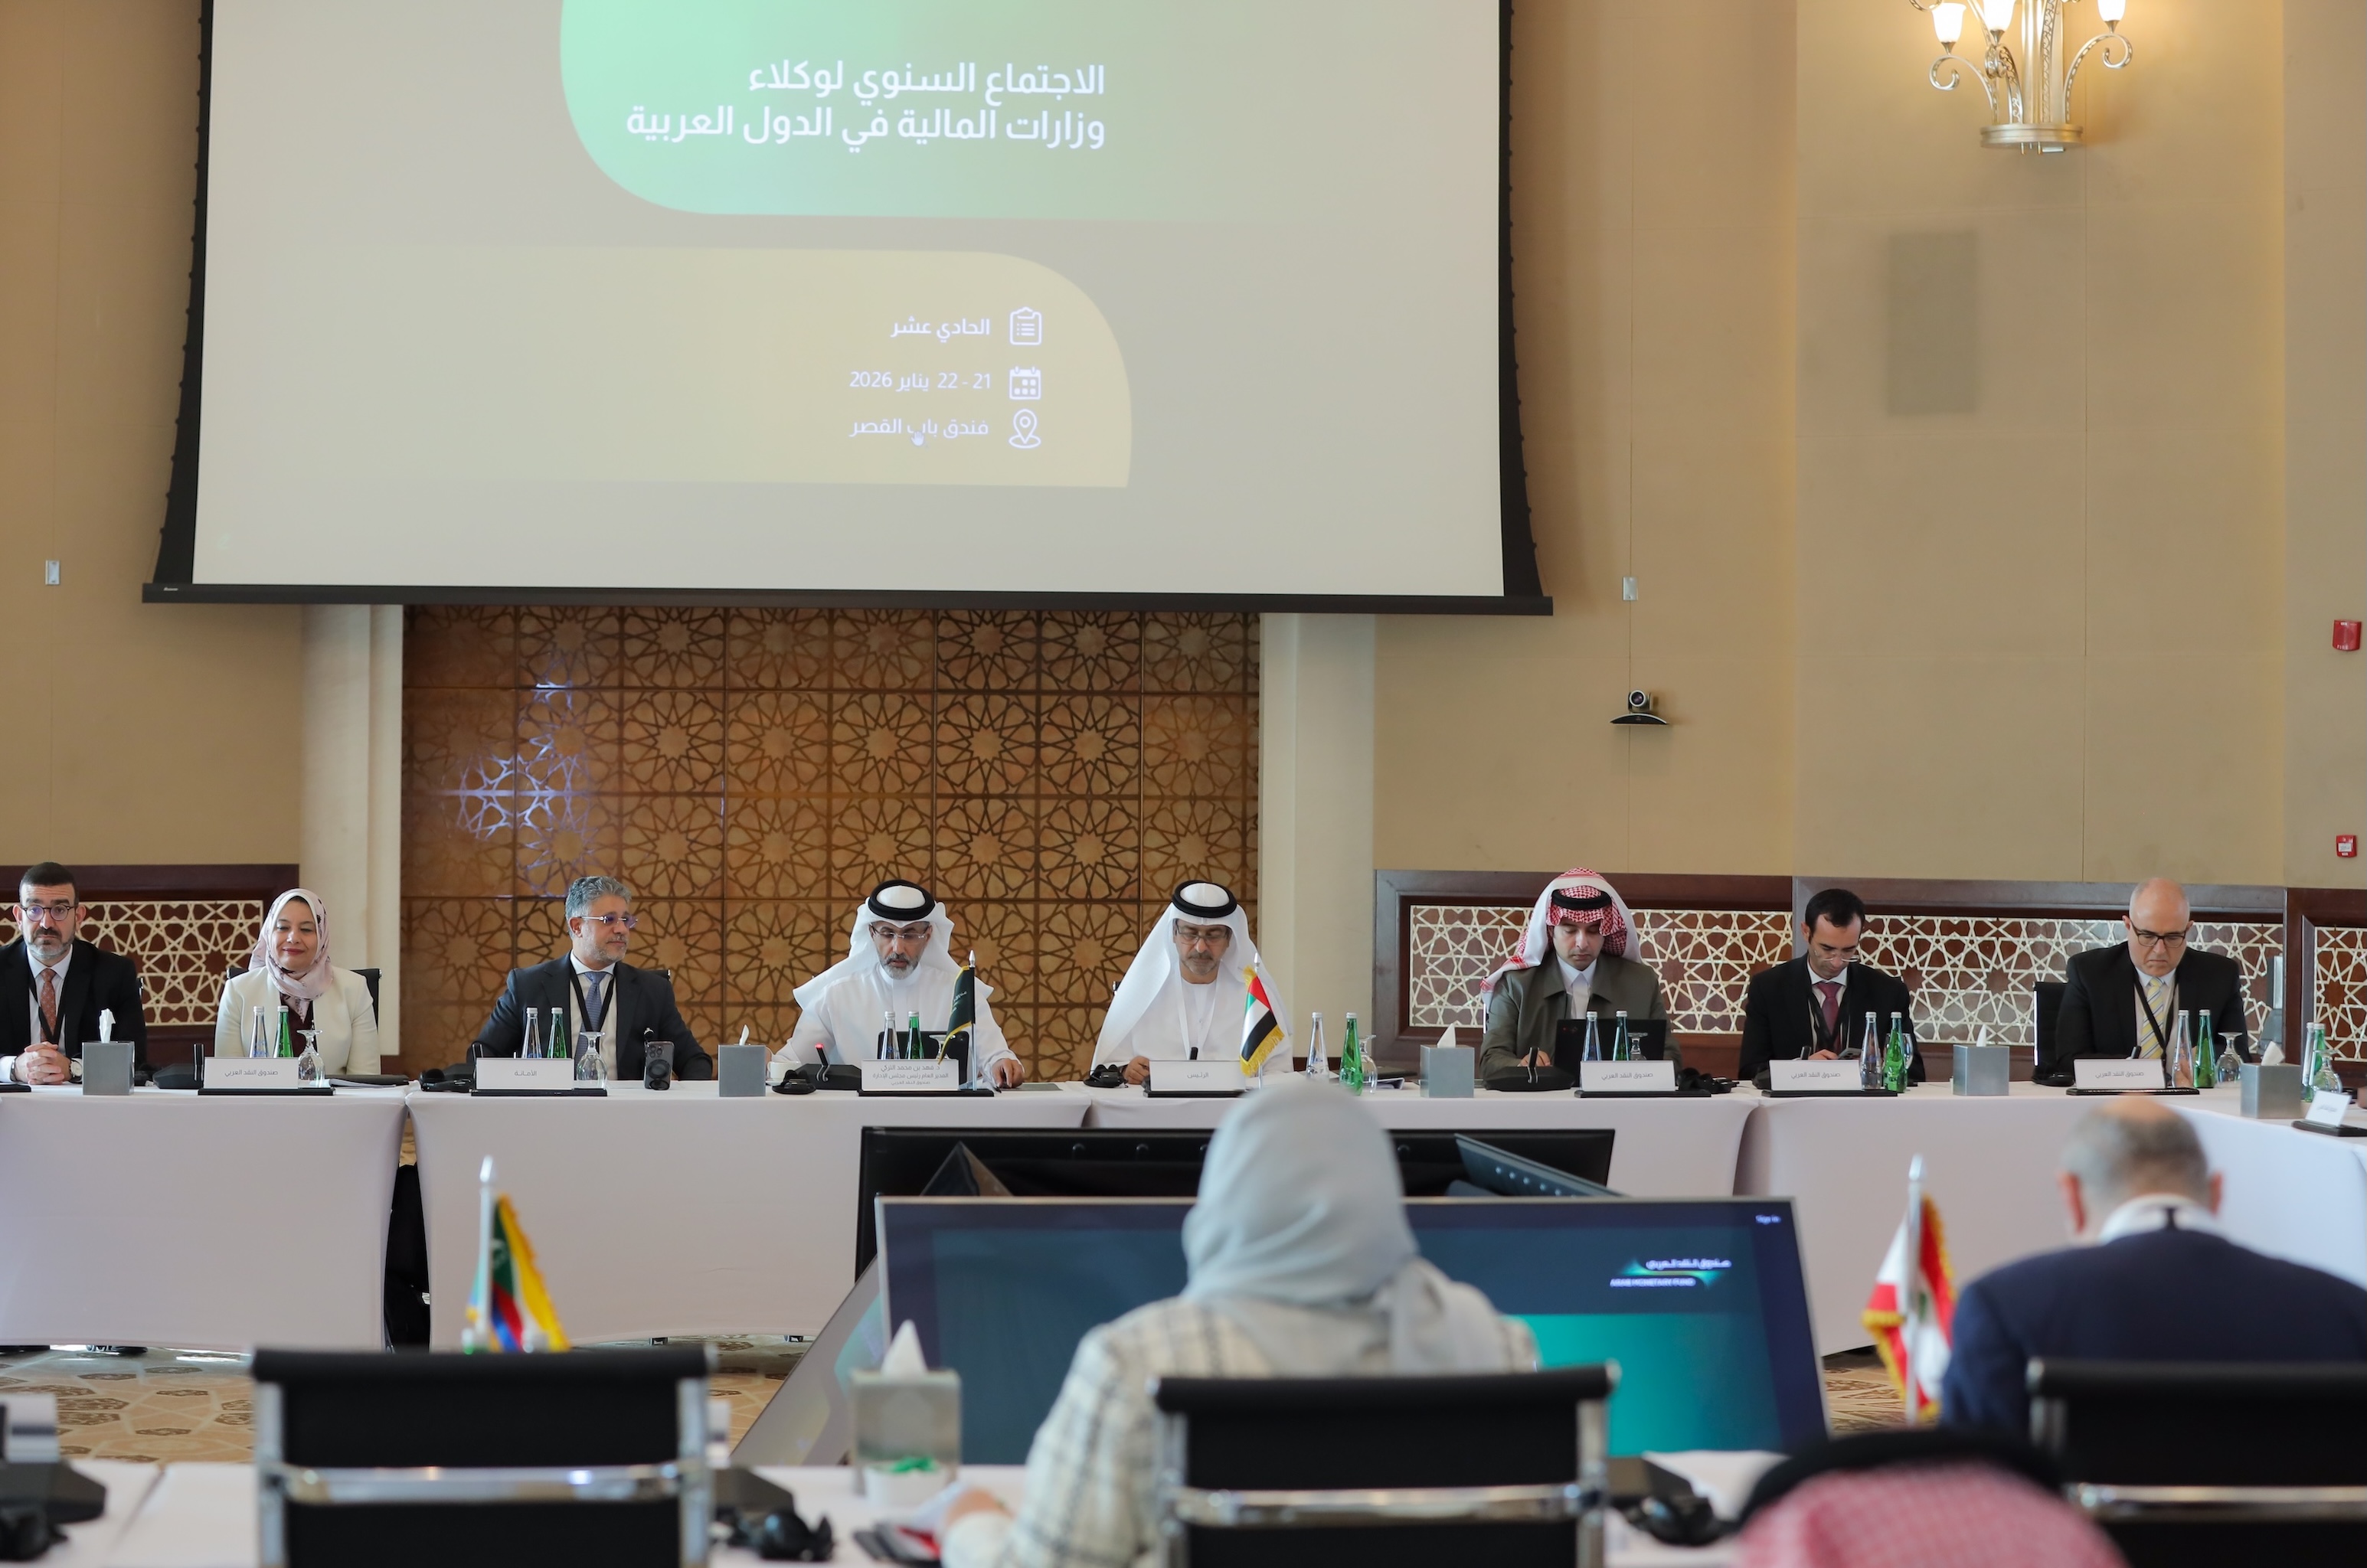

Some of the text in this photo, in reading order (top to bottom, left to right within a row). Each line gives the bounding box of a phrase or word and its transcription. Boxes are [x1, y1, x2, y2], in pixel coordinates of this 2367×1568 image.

[748, 60, 1105, 106] الاجتماع السنوي لوكلاء
[626, 104, 1105, 154] وزارات المالية في الدول العربية
[890, 315, 991, 343] الحادي عشر
[849, 371, 893, 387] 2026
[895, 371, 930, 392] يناير
[937, 372, 959, 389] 22
[973, 373, 991, 389] 21
[849, 417, 902, 437] القصر
[943, 418, 989, 439] فندق
[514, 1069, 538, 1077] الأمانة
